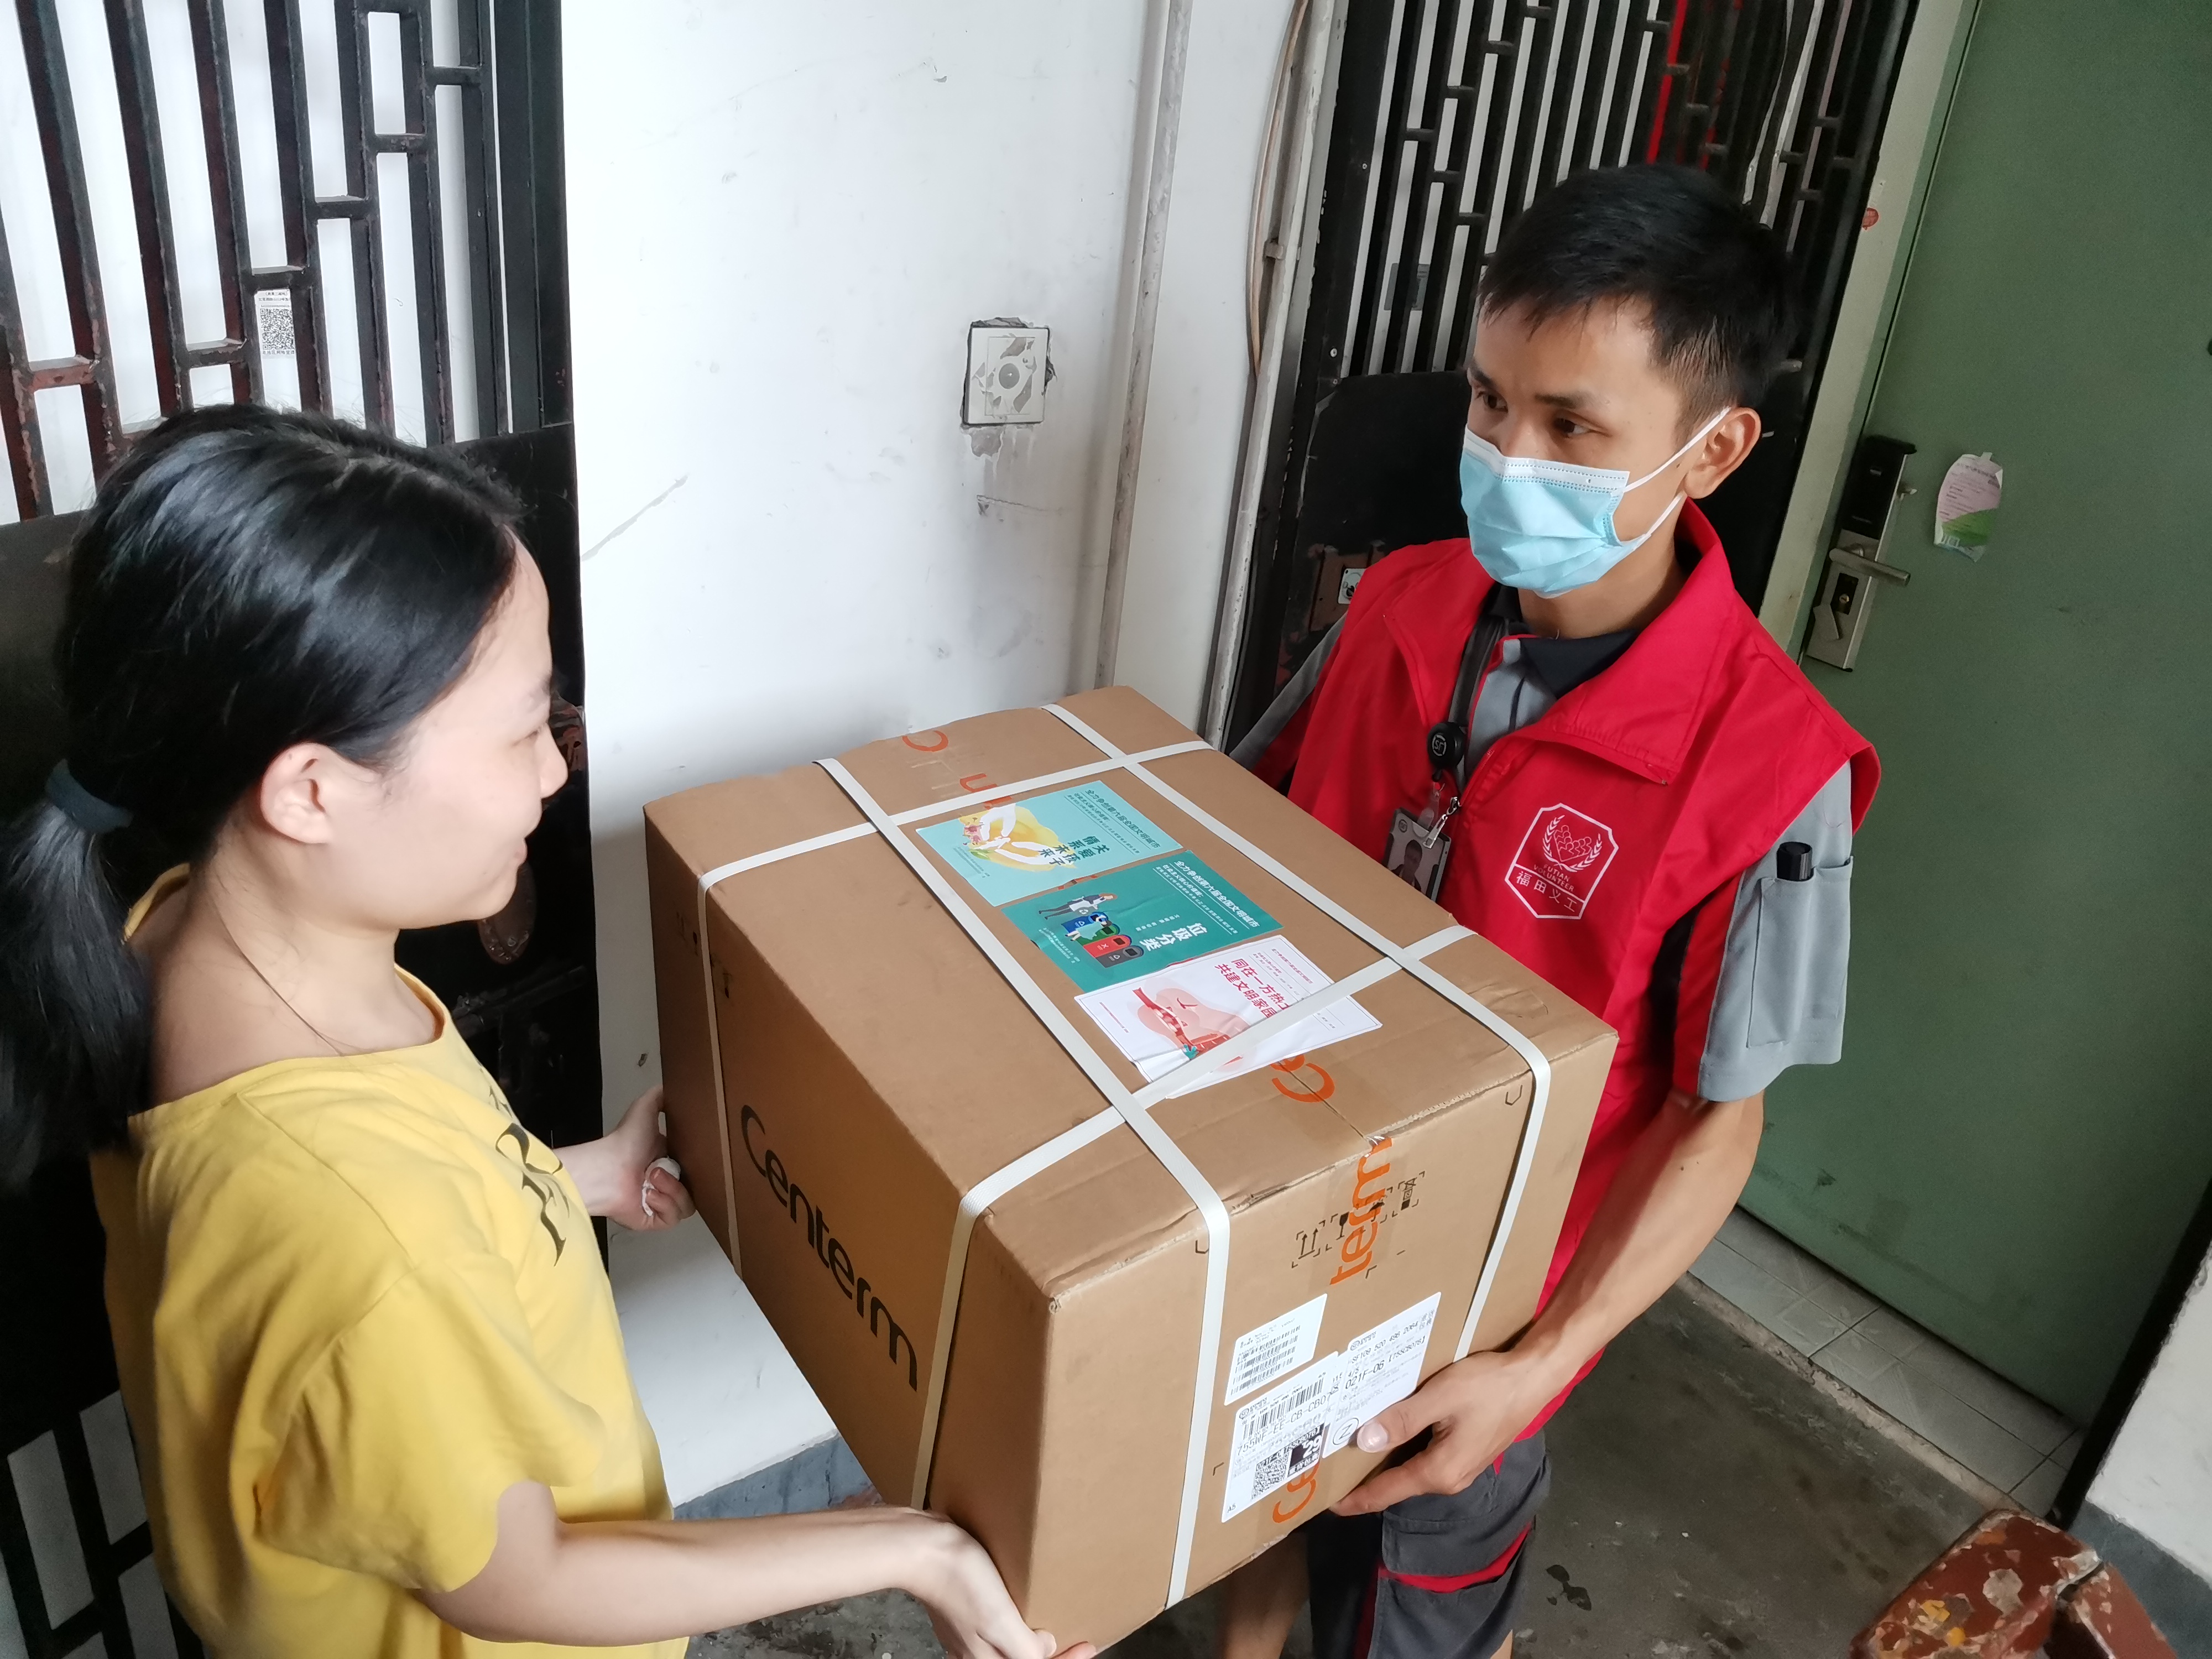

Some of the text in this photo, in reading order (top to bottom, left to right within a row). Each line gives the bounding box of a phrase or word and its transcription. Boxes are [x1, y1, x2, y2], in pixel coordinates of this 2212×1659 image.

[1038, 835, 1099, 859] 情系未来
[1048, 844, 1110, 868] 关爱孩子
[1533, 864, 1574, 892] VOLUNTEER
[1543, 864, 1571, 882] FUTIAN
[1173, 859, 1261, 928] 全力争创第六届全国文明城市
[1516, 870, 1577, 912] 福田义工
[1139, 922, 1208, 951] 垃圾分类
[1214, 963, 1277, 1018] 共建文明家园
[741, 1104, 917, 1392] Centerm
[1227, 1504, 1236, 1512] A5
